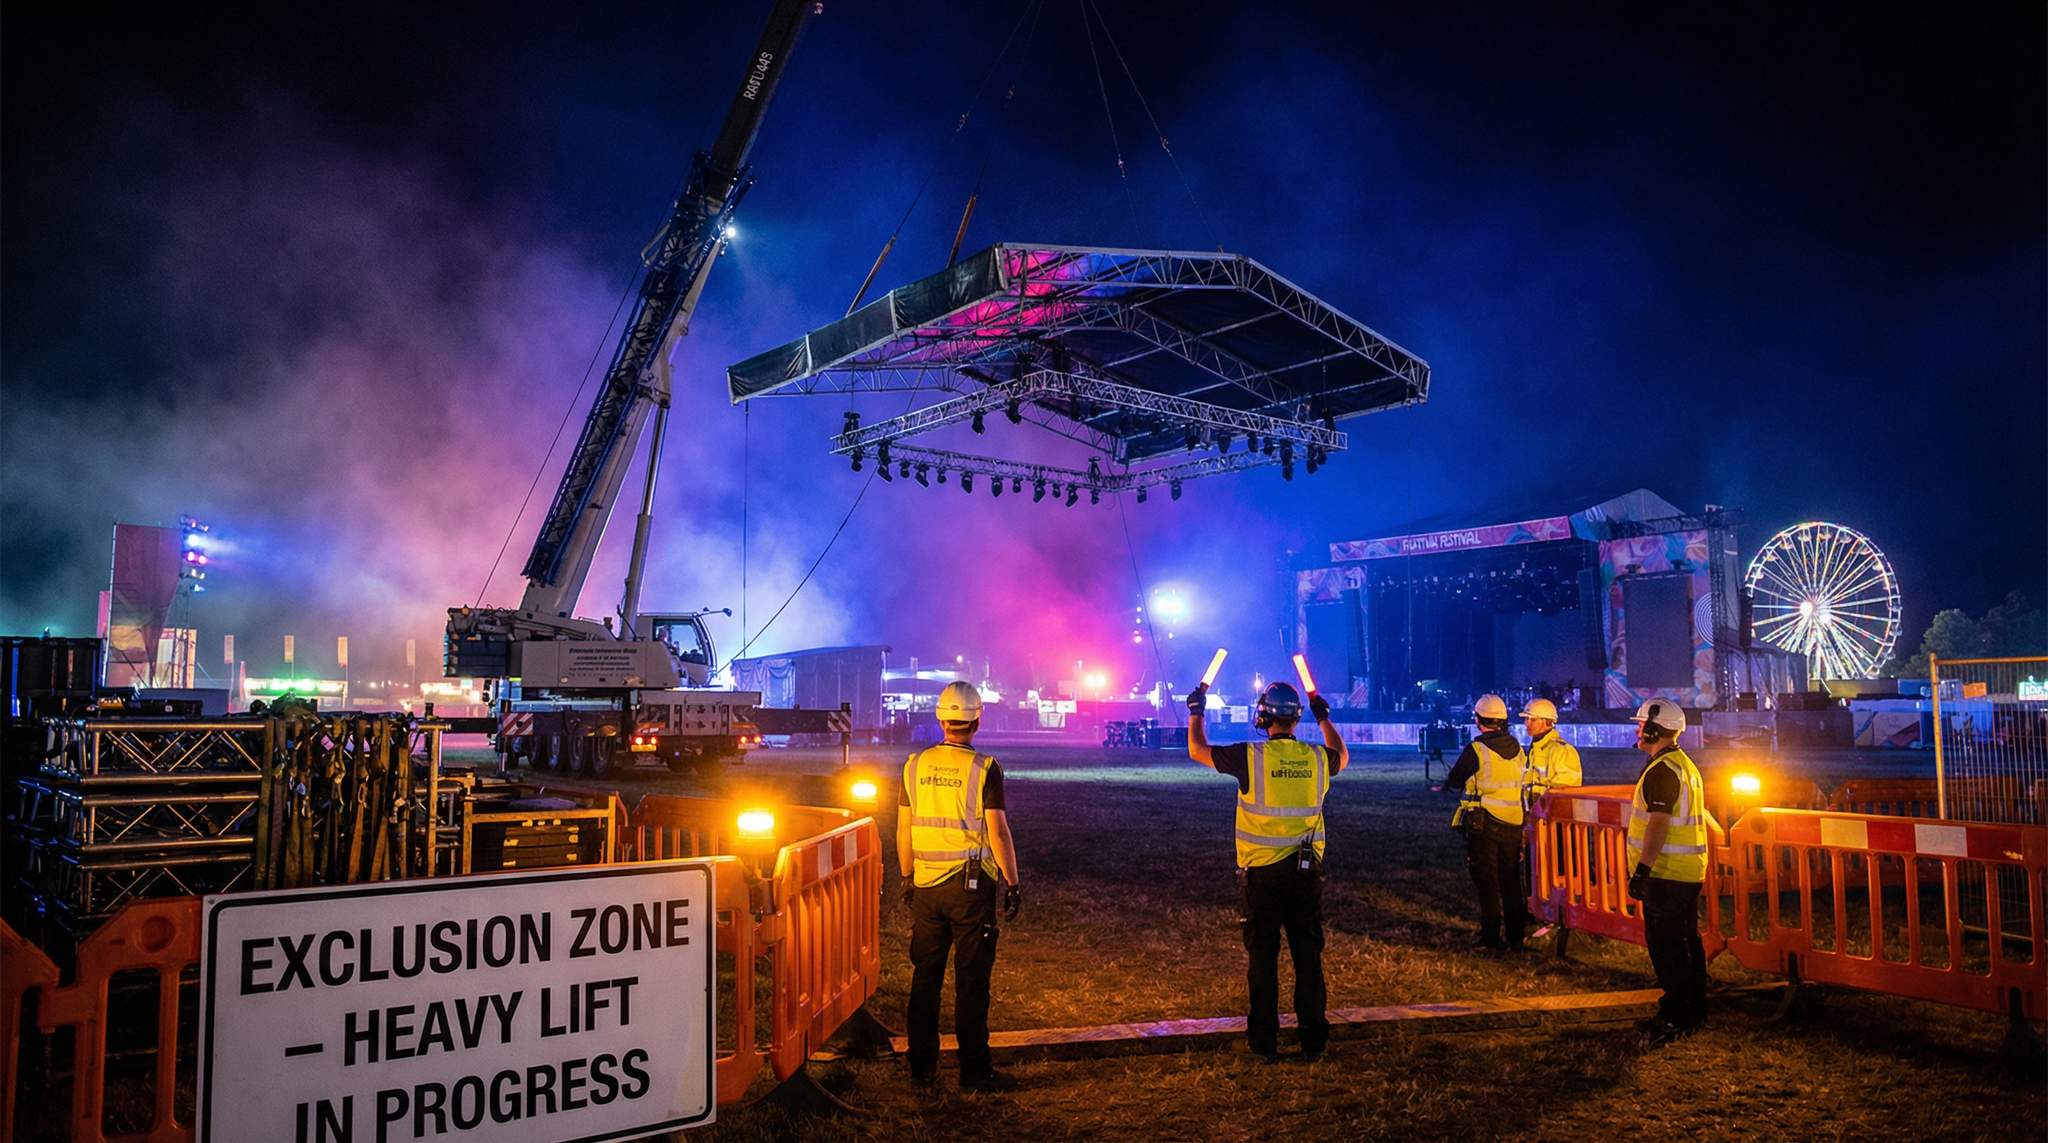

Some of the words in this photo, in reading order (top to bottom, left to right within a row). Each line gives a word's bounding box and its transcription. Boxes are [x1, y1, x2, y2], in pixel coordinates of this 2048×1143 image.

[239, 911, 553, 996] EXCLUSION
[569, 898, 690, 959] ZONE
[343, 990, 524, 1067] HEAVY
[541, 976, 640, 1037] LIFT
[297, 1096, 353, 1143] IN
[376, 1048, 651, 1138] PROGRESS
